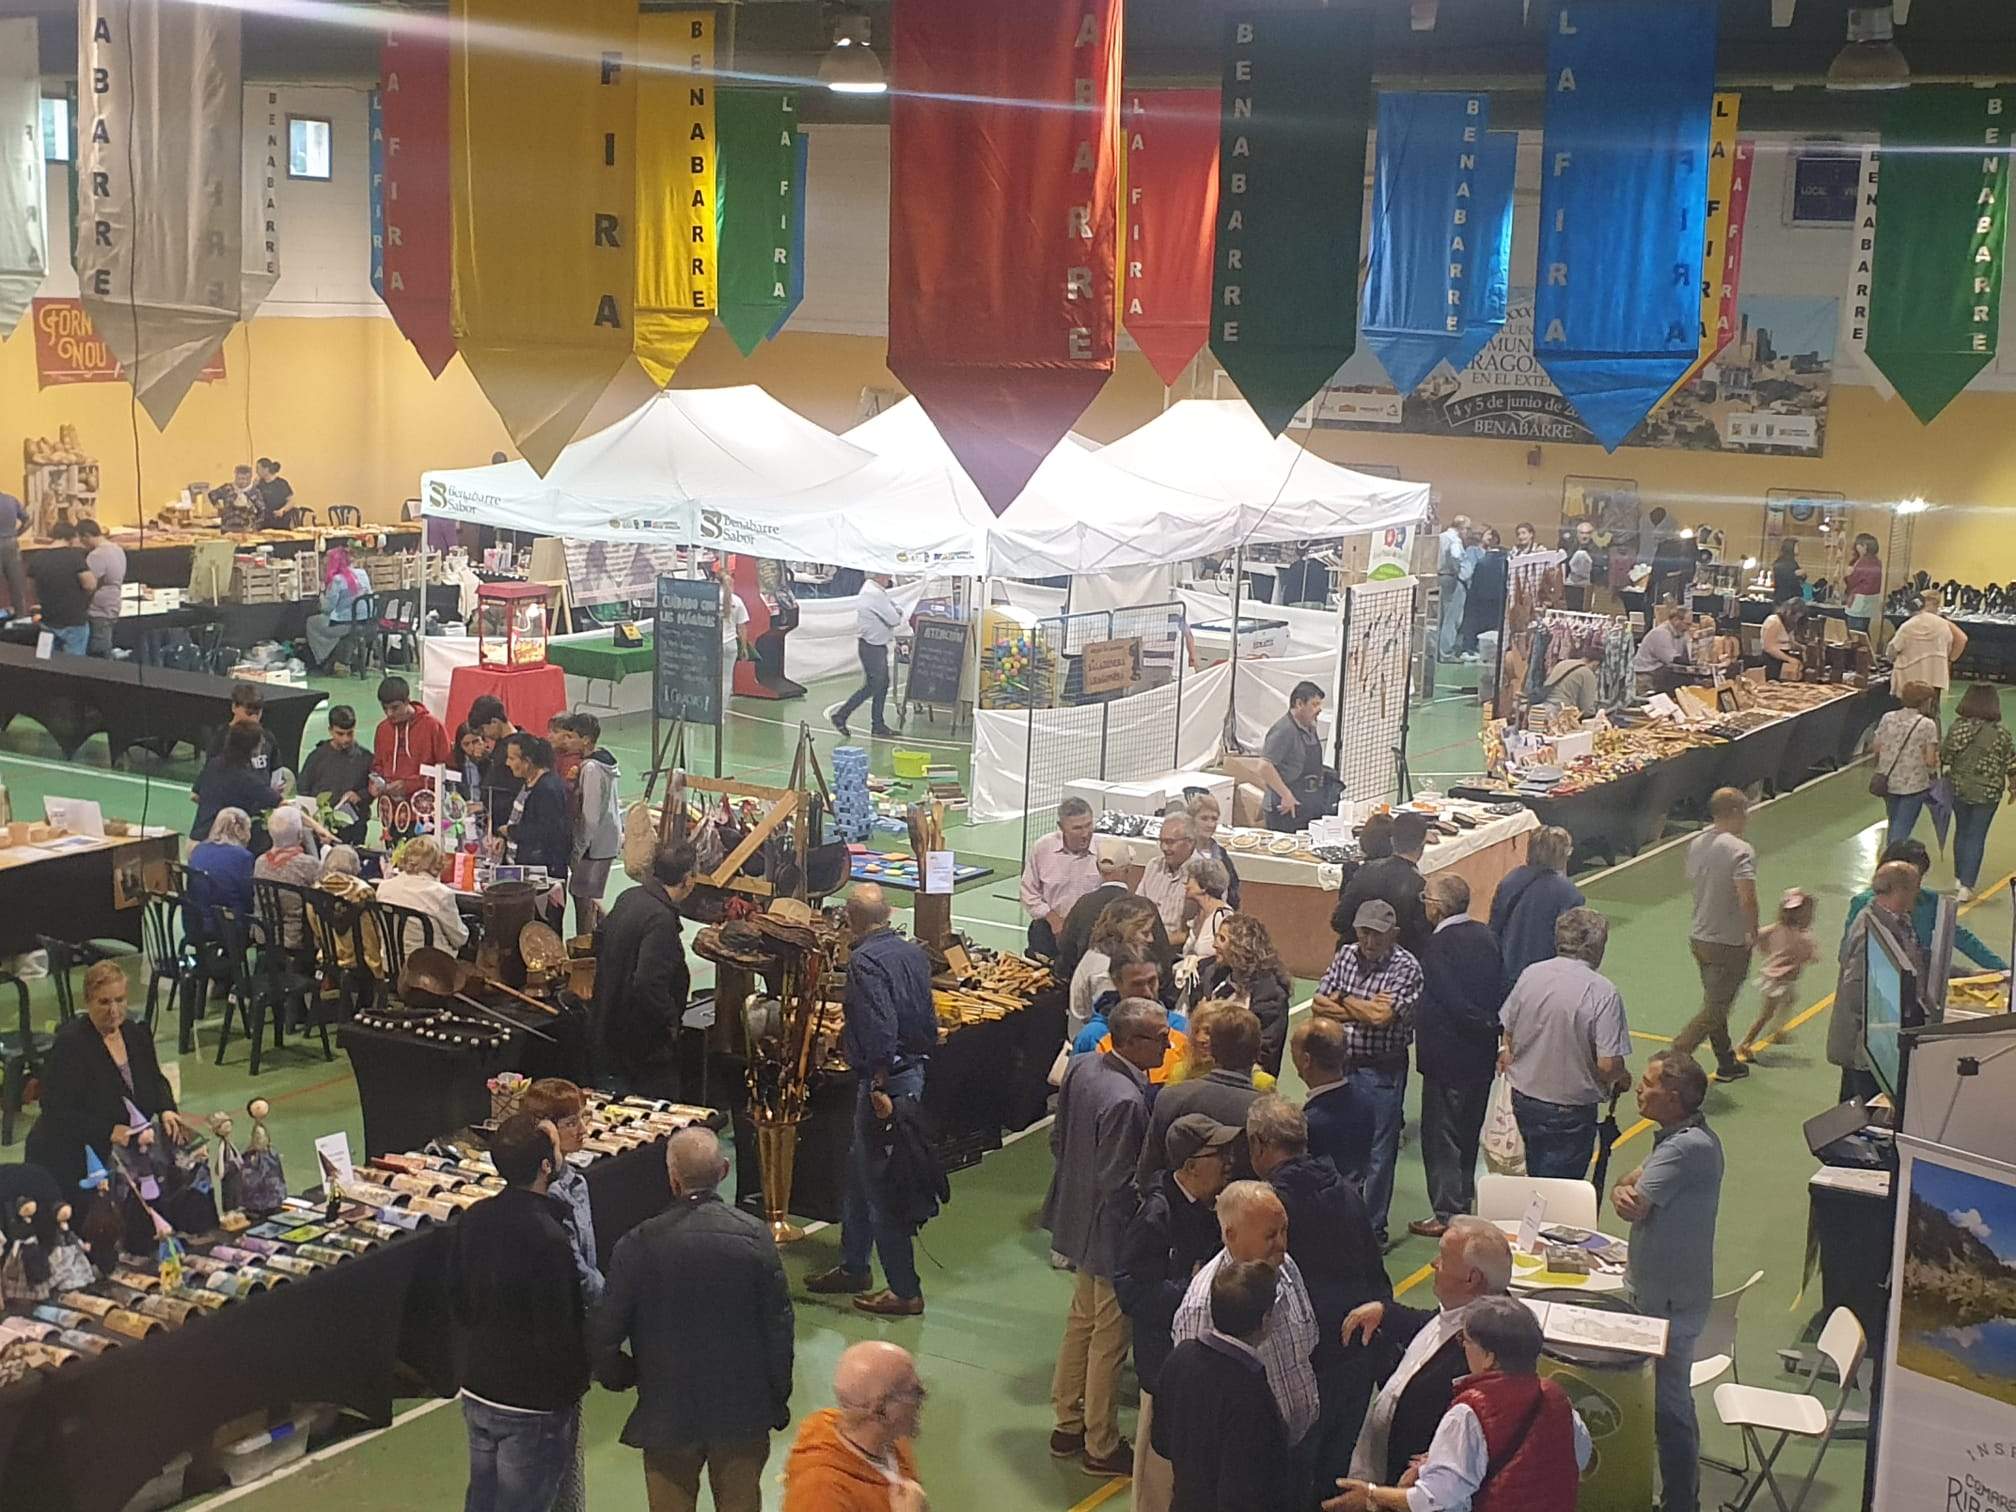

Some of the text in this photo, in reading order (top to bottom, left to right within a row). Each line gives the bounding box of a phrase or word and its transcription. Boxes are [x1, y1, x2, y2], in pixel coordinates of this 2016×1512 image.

[266, 92, 277, 274] BENABARRE
[386, 31, 406, 291] LA FIRA
[593, 51, 622, 329] FIRA
[689, 20, 706, 308] BENABARRE
[774, 97, 793, 298] LA FIRA
[1129, 97, 1145, 315] LA FIRA
[1223, 23, 1254, 342] BENABARRE
[1447, 100, 1480, 331] BENABARRE
[1545, 10, 1577, 343] LA FIRA
[1710, 101, 1729, 159] LA
[1973, 98, 2003, 352] BENABARRE
[1717, 145, 1747, 331] LA FIRA
[1453, 404, 1462, 417] 4
[1463, 402, 1474, 418] y
[1475, 396, 1485, 411] 5
[1486, 395, 1504, 409] de
[1506, 394, 1542, 412] junio
[1544, 398, 1562, 413] de
[1470, 353, 1537, 374] RAGO
[1472, 372, 1490, 385] EN
[1494, 373, 1510, 385] EL
[1474, 418, 1574, 439] BENABARRE
[722, 513, 781, 535] Benabarre
[722, 529, 756, 545] Sabor
